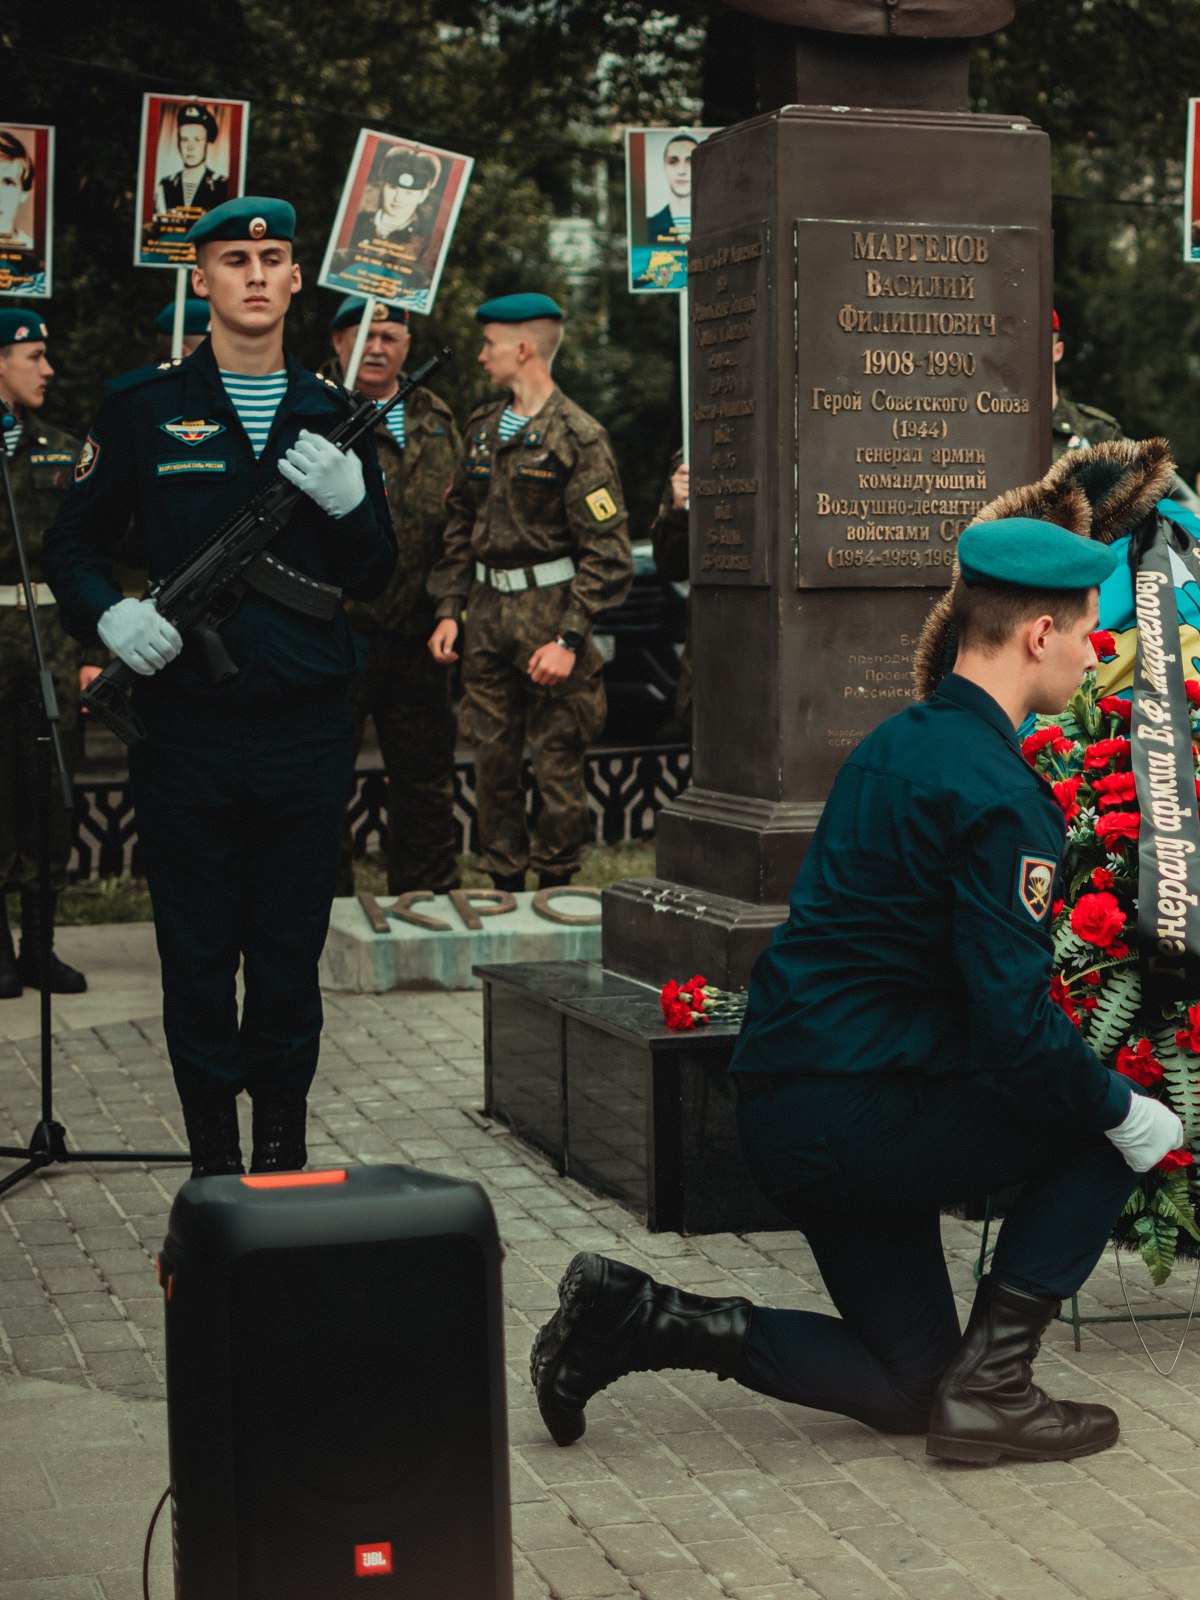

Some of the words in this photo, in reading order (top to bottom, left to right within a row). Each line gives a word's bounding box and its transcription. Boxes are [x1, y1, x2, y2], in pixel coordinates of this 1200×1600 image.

[853, 231, 989, 263] МАРГЕЛОВ
[811, 387, 862, 415] Герой
[871, 388, 967, 413] Советского
[976, 391, 1030, 414] Союза
[892, 418, 948, 440] (1944)
[856, 448, 923, 468] генерал
[931, 448, 987, 468] армии
[859, 470, 987, 494] командующий
[847, 521, 930, 542] войсками
[939, 519, 970, 542] СС
[1135, 571, 1177, 696] Маргелову
[1136, 698, 1176, 748] В.Ф.
[1147, 750, 1193, 832] армии
[356, 885, 603, 934] КРО
[361, 1550, 387, 1567] JBL
